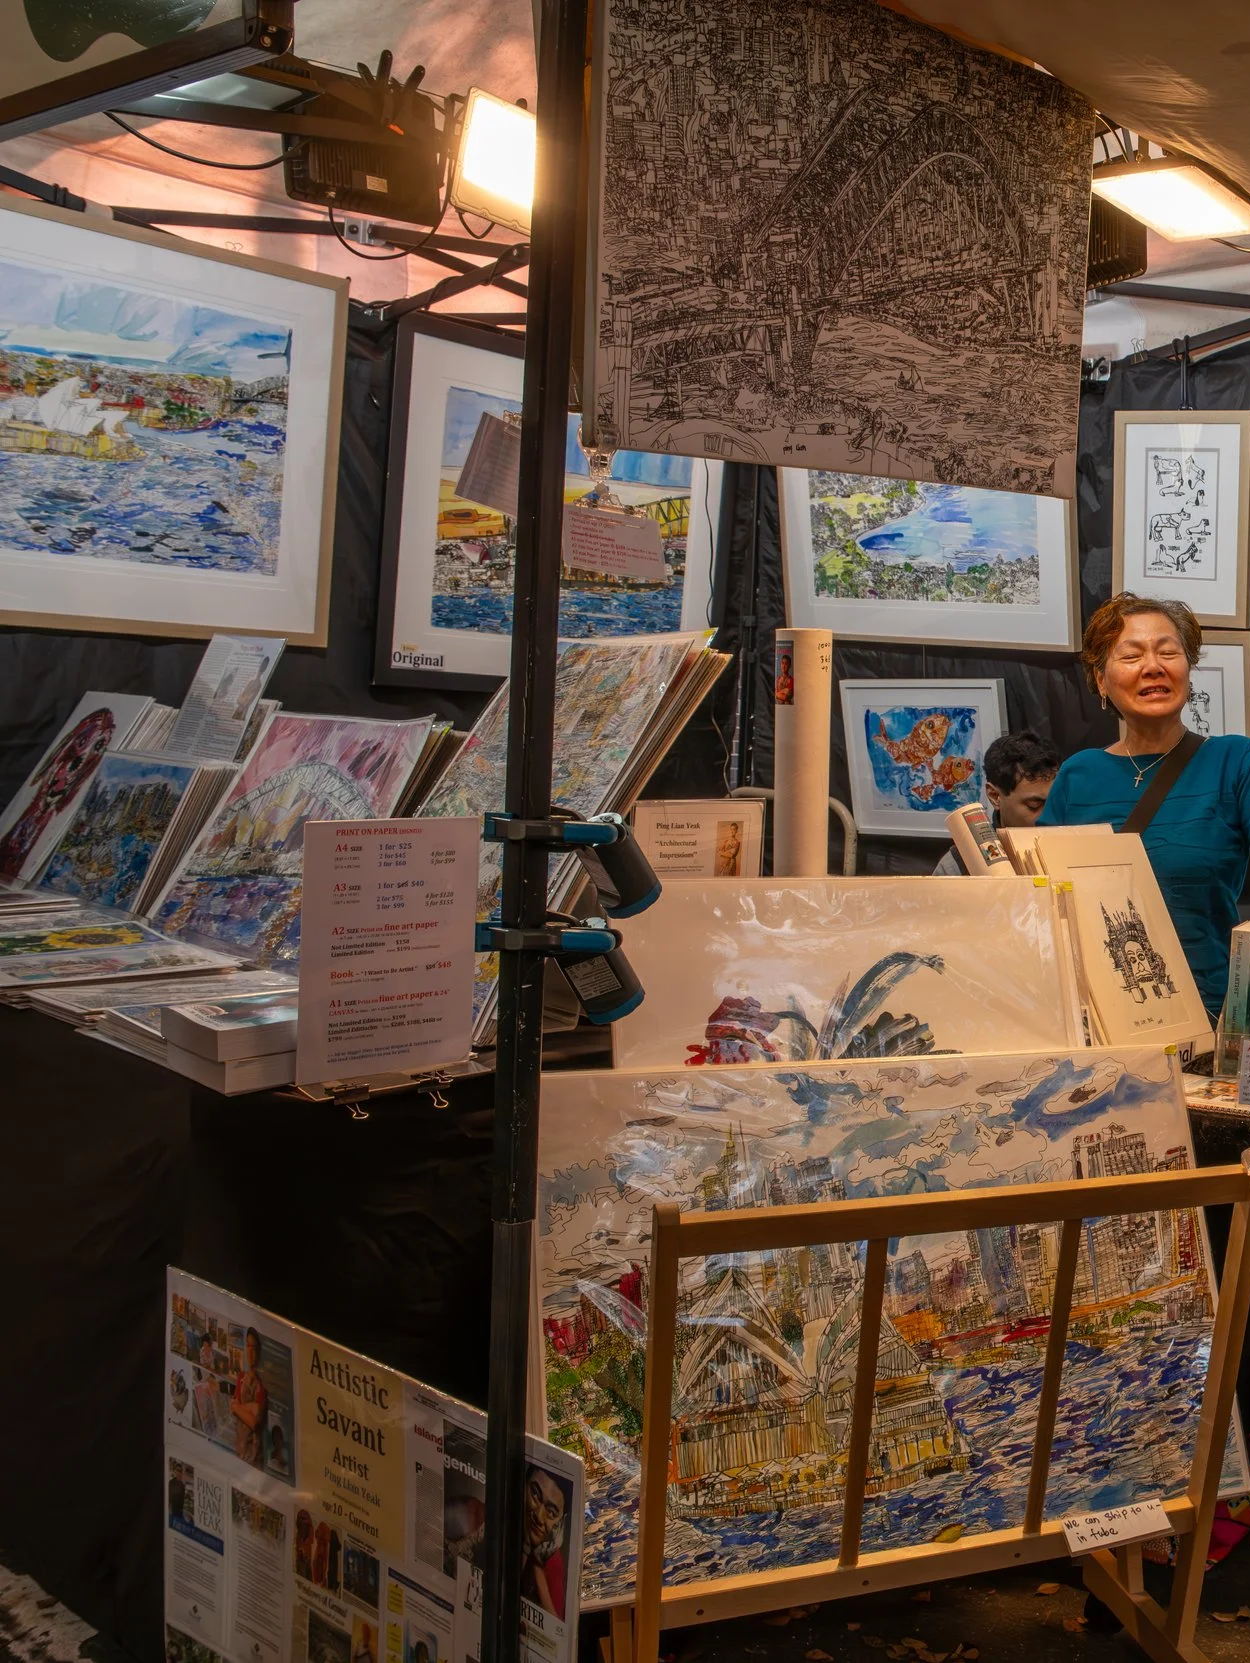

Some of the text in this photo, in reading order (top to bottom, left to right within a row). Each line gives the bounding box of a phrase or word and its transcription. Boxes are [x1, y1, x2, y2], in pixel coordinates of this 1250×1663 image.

[393, 651, 444, 668] Original
[336, 828, 360, 836] PRINT
[361, 828, 372, 836] ON
[373, 827, 398, 836] PAPER
[656, 822, 669, 830] Ping
[335, 844, 348, 853] A4
[398, 842, 413, 850] $25
[434, 850, 443, 858] for
[434, 858, 444, 866] for
[333, 883, 347, 892] A3
[411, 880, 425, 888] $40
[429, 900, 439, 908] for
[332, 926, 345, 935] A2
[384, 923, 400, 932] fine
[401, 922, 413, 930] art
[415, 921, 439, 931] paper
[365, 941, 386, 949] Edition
[331, 950, 354, 958] Limited
[354, 949, 375, 957] Edition
[330, 969, 354, 980] Book
[329, 999, 341, 1009] A1
[379, 994, 394, 1003] fine
[396, 993, 408, 1001] art
[410, 989, 434, 1001] paper
[329, 1008, 354, 1017] CANVAS
[340, 1020, 361, 1028] Limited
[362, 1017, 383, 1025] Edition
[328, 1028, 350, 1036] Limited
[310, 1348, 389, 1410] Autistic
[316, 1396, 386, 1456] Savant
[414, 1423, 443, 1446] Island
[332, 1446, 370, 1481] Artist
[444, 1453, 486, 1485] genius
[196, 1477, 222, 1502] PING
[324, 1466, 342, 1488] Ping
[343, 1477, 360, 1495] Lian
[361, 1487, 380, 1508] Yeak
[197, 1492, 222, 1516] LIAN
[1131, 1506, 1141, 1515] to
[197, 1508, 222, 1534] YEAK
[332, 1502, 343, 1517] 10
[348, 1511, 379, 1539] Current
[1076, 1527, 1118, 1543] in tube
